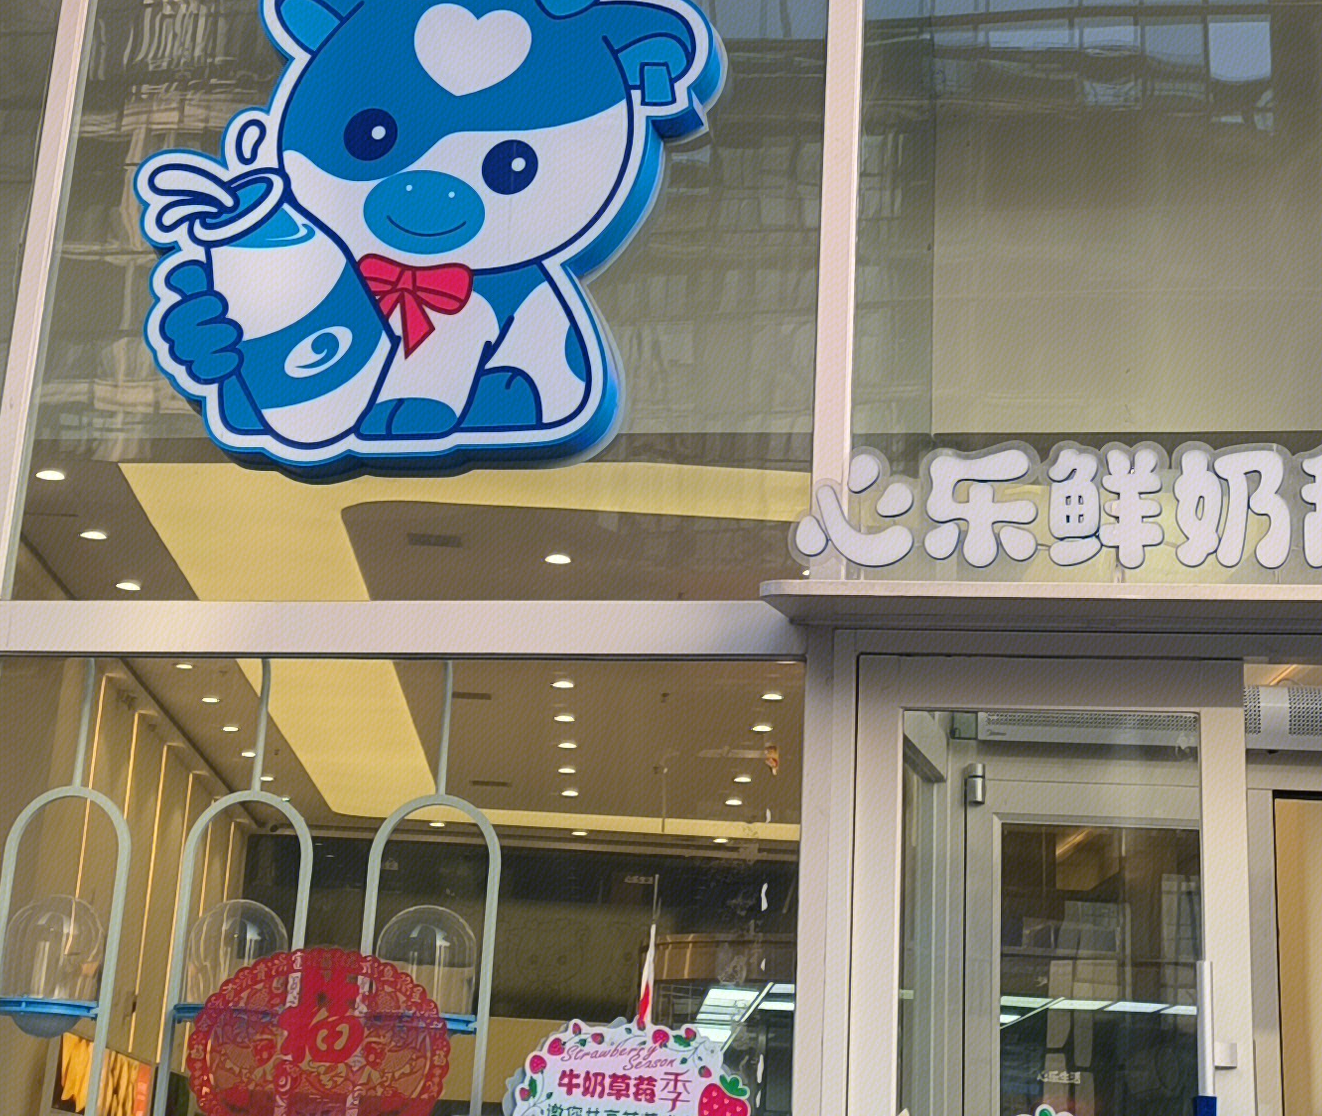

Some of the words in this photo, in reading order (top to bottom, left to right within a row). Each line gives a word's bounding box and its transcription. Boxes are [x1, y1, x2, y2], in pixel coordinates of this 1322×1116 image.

[560, 1044, 659, 1062] Strawberry
[622, 1053, 677, 1071] Season
[557, 1068, 693, 1113] 牛奶草莓季
